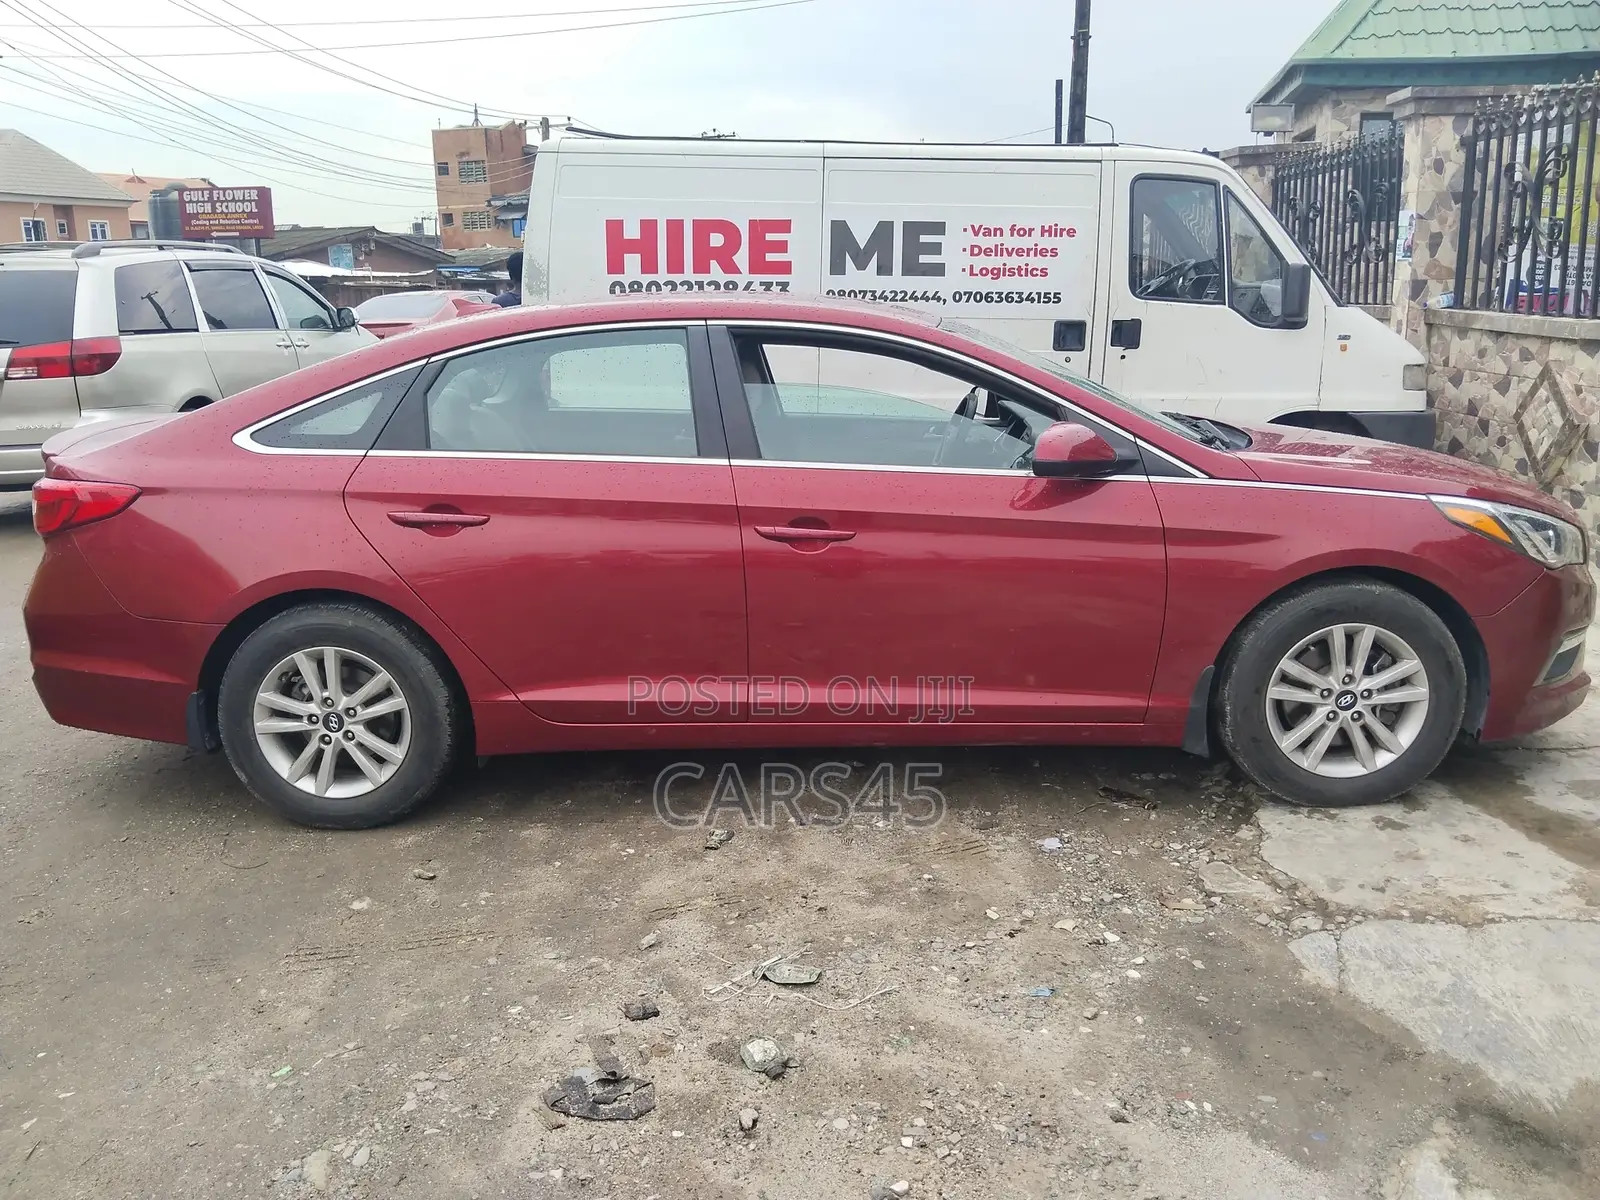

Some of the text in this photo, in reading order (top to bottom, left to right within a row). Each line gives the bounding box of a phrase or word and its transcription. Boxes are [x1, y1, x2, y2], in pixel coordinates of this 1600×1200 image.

[183, 189, 258, 202] GULF FLOWER
[186, 201, 258, 214] HIGH SCHOOL
[970, 223, 1077, 238] Van for Hire
[605, 219, 947, 277] HIRE ME
[969, 243, 1059, 258] Deliveries
[969, 263, 1049, 281] Logistics
[952, 291, 1062, 305] 07063634155
